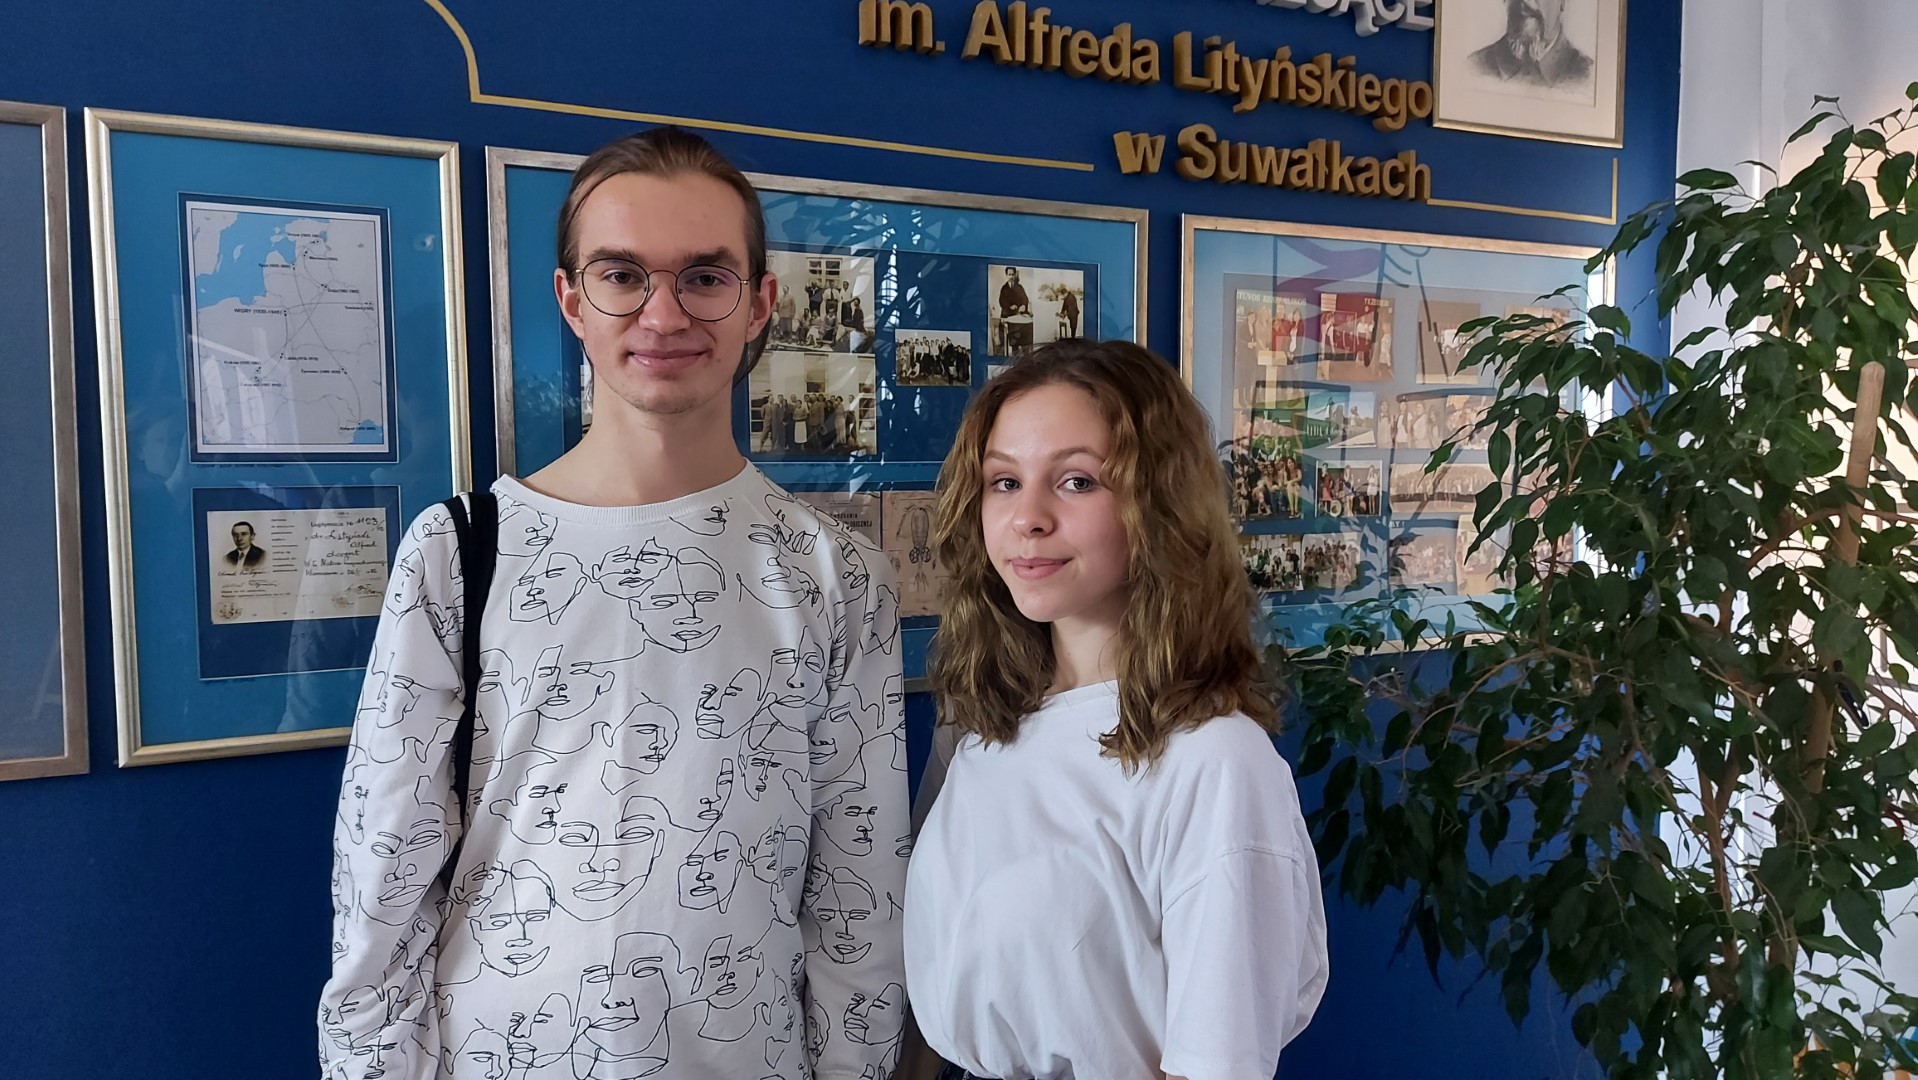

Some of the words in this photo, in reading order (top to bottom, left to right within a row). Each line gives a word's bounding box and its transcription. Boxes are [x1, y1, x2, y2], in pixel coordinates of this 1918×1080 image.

[961, 0, 1160, 85] Alfreda
[1173, 31, 1433, 132] Lityńskiego
[1113, 131, 1166, 174] w
[1175, 123, 1431, 200] Suwałkach
